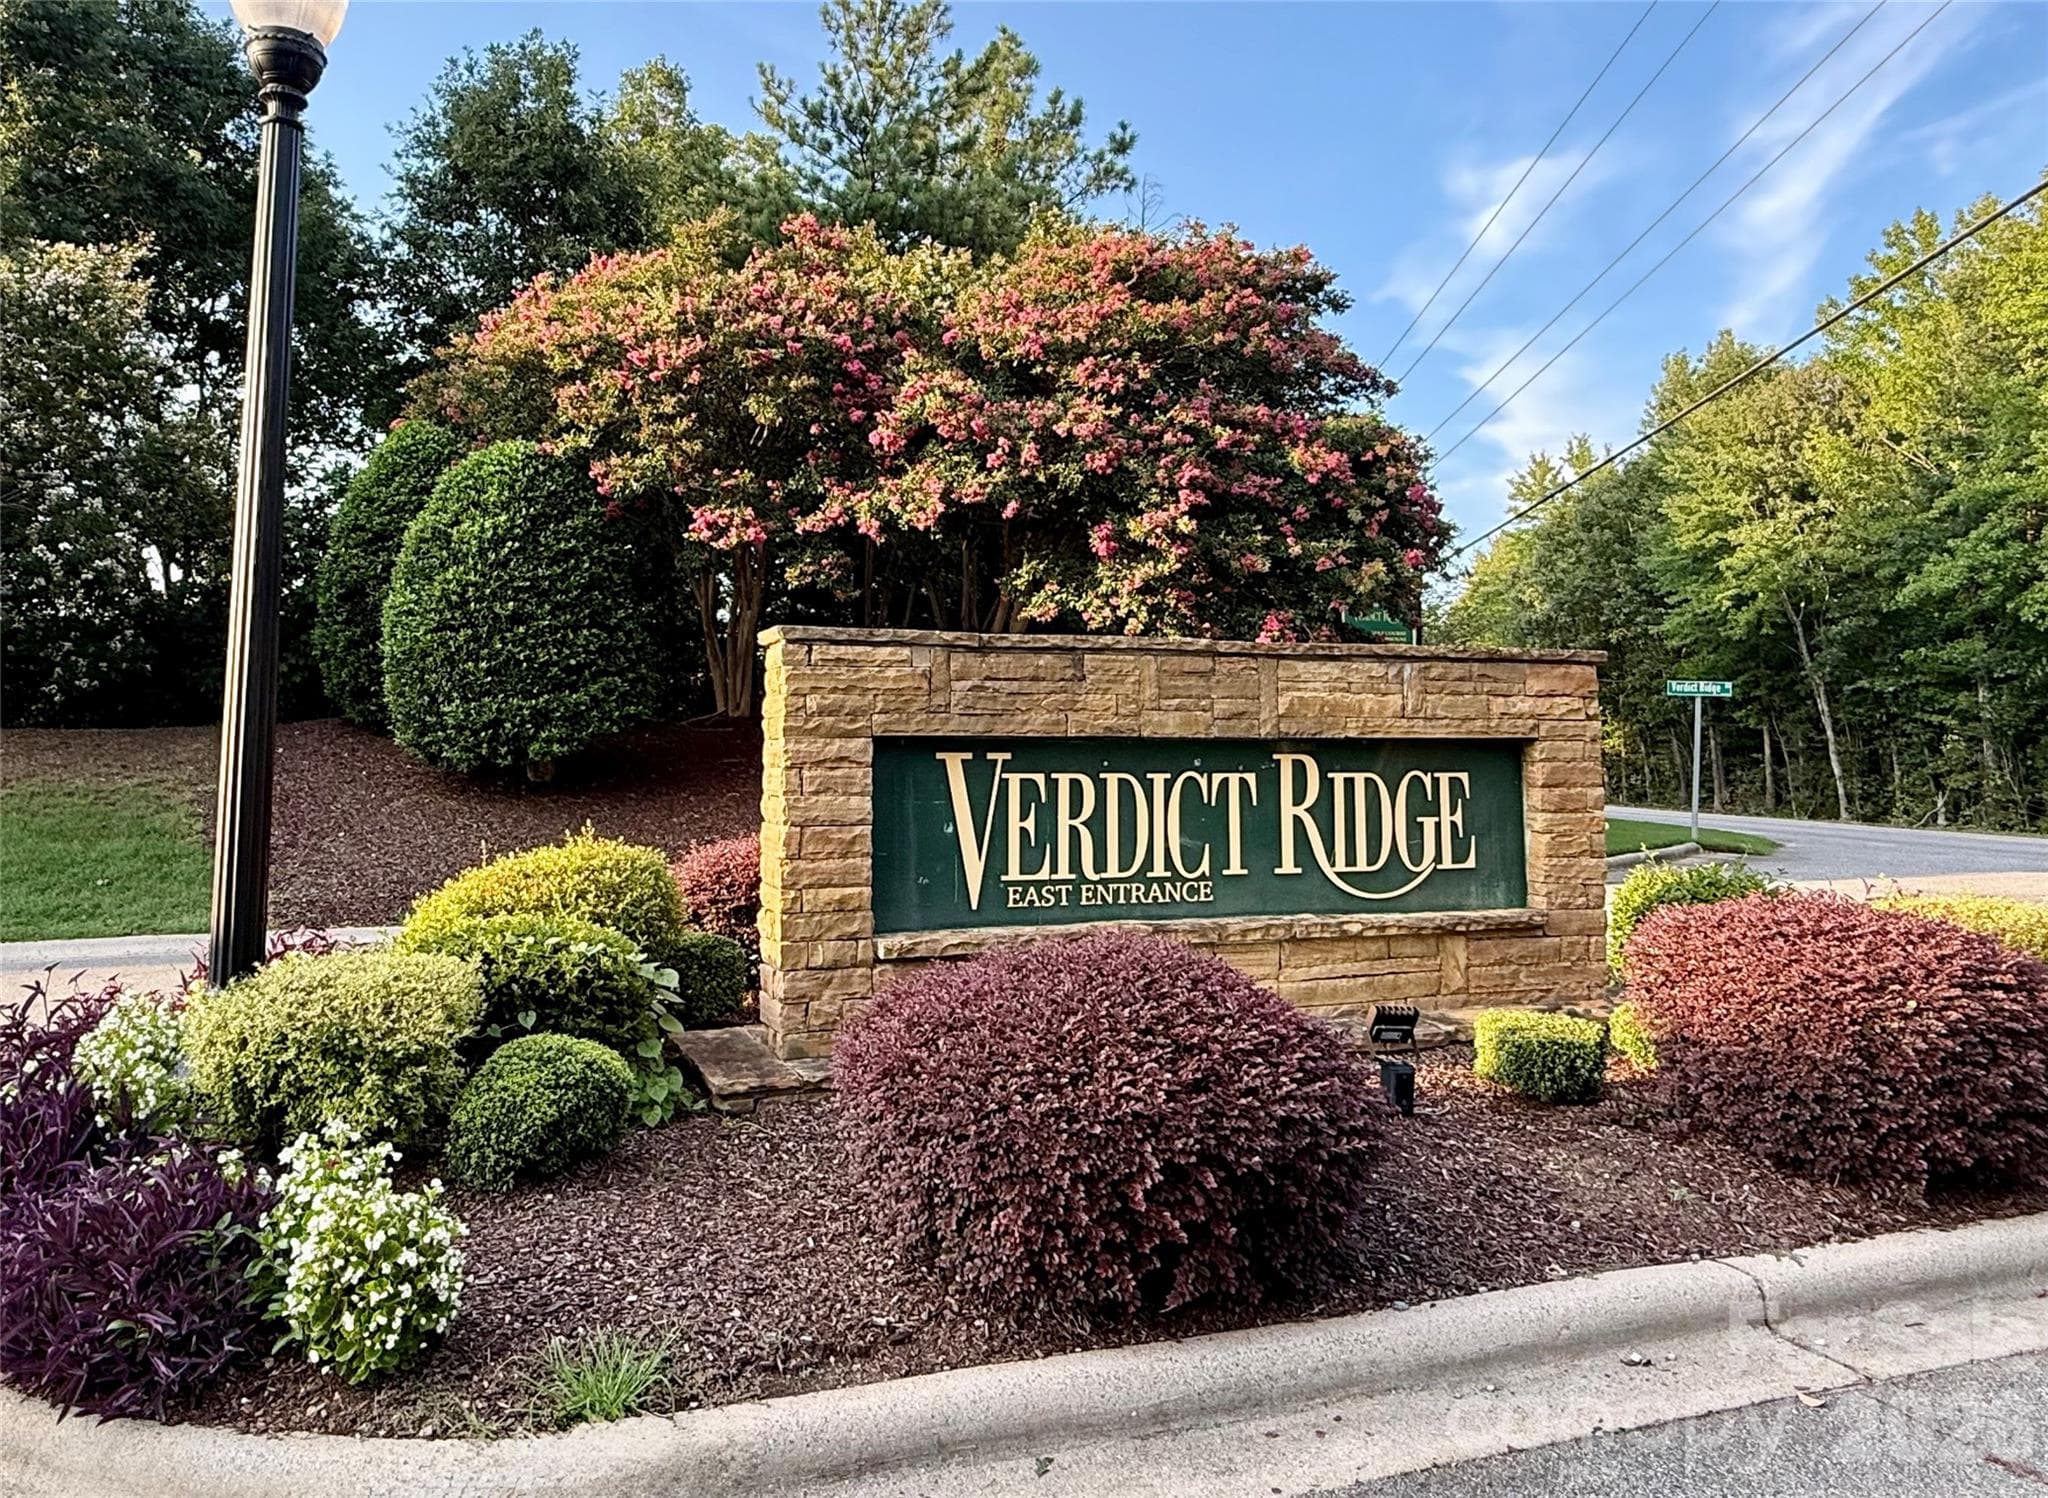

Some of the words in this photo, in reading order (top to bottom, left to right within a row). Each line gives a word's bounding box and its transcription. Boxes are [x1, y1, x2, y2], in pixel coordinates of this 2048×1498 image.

[1671, 681, 1698, 693] Verdict
[1700, 681, 1721, 695] Ridge
[935, 751, 1258, 911] VERDICT
[1273, 753, 1477, 900] RIDGE
[1006, 884, 1073, 909] EAST
[1079, 880, 1214, 906] ENTRANCE
